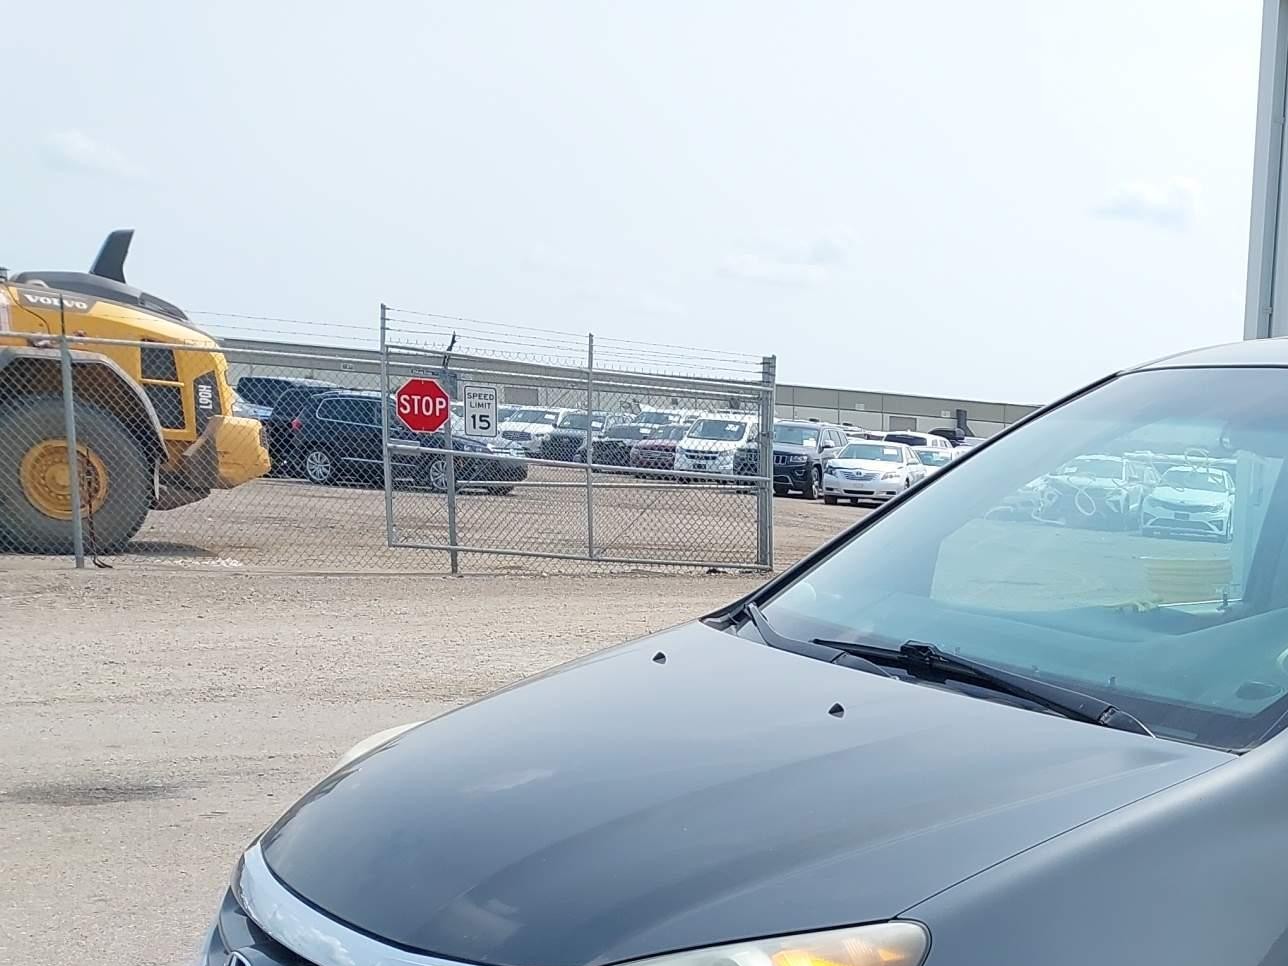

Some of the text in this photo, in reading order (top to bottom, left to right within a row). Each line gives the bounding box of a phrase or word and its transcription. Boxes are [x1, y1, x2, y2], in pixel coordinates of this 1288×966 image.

[24, 294, 89, 310] VOLVO
[198, 384, 213, 409] L90H
[467, 392, 494, 401] SPEED
[400, 395, 446, 416] STOP
[471, 414, 491, 430] 15
